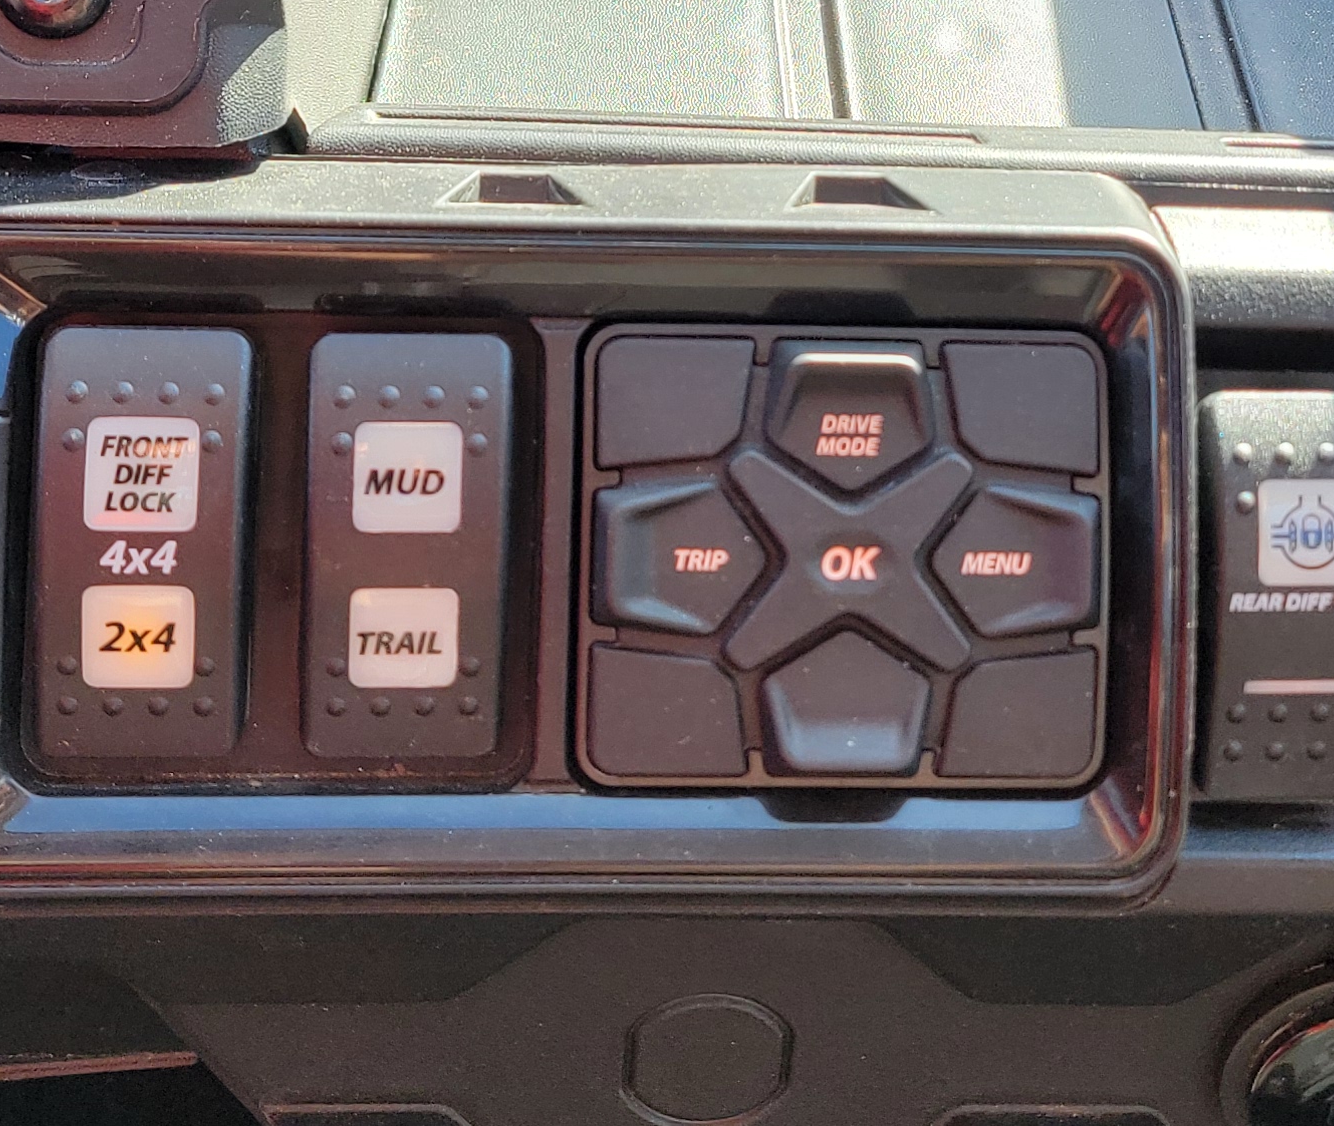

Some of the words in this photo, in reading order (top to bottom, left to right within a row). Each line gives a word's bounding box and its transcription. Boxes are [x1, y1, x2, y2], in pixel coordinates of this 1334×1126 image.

[820, 413, 884, 436] DRIVE
[100, 435, 188, 459] FRONT
[815, 436, 881, 457] MODE
[113, 464, 173, 486] DIFF
[363, 468, 445, 496] MUD
[104, 491, 177, 514] LOCK
[99, 539, 178, 575] 4x4
[673, 548, 731, 572] TRIP
[820, 545, 882, 581] OK
[960, 550, 1034, 576] MENU
[1228, 591, 1285, 613] REAR
[1285, 591, 1333, 613] DIFF
[98, 621, 178, 654] 2x4
[356, 630, 444, 656] TRAIL
